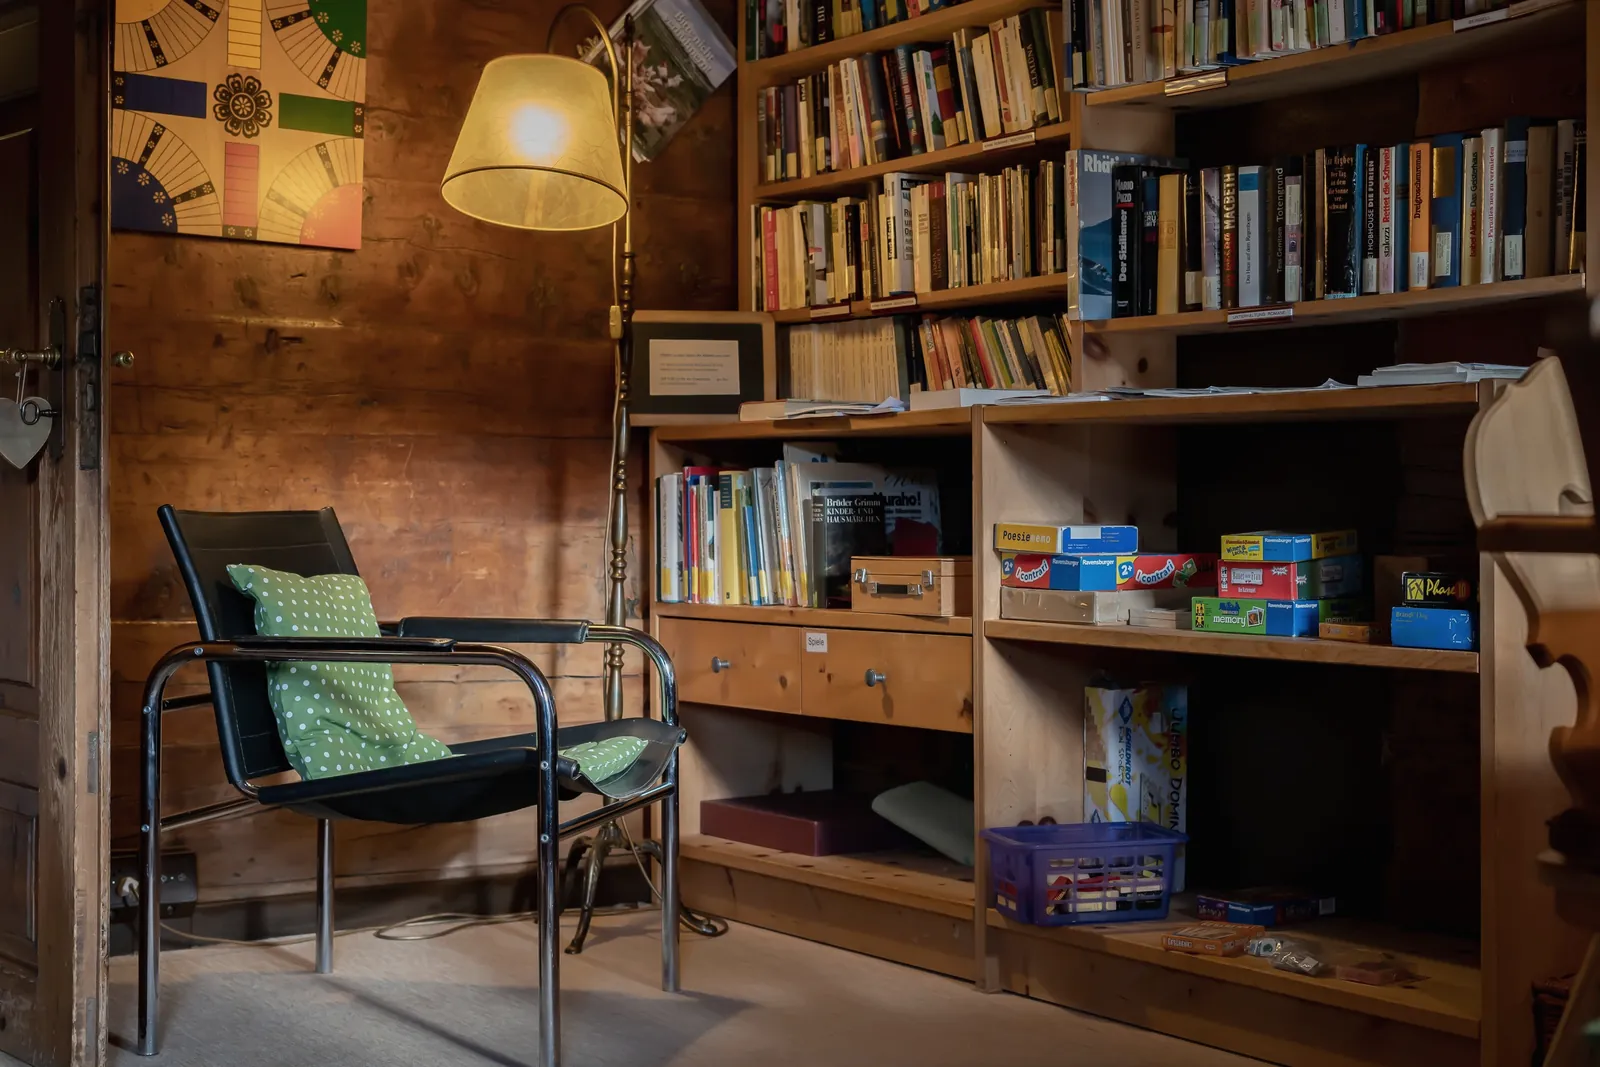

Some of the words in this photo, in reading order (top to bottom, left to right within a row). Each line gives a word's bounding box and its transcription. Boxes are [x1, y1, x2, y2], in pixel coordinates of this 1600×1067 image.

[816, 4, 826, 41] RBB
[1366, 160, 1374, 191] FURIEN
[1382, 148, 1390, 180] Schweiz
[1470, 152, 1478, 192] Geisterhaus
[1275, 167, 1284, 222] Totengrund
[1414, 150, 1423, 219] Dreigroschenroman
[1222, 172, 1235, 230] MACBETH
[1366, 192, 1374, 208] DIE
[1119, 209, 1128, 260] Sizilianer
[1367, 210, 1375, 251] HOBHOUSE
[1383, 227, 1391, 258] stalozzi
[1119, 261, 1128, 282] Der
[827, 498, 853, 507] Brüder
[854, 498, 881, 507] Grimm
[827, 507, 856, 515] KINDER-
[827, 515, 882, 523] HAUSMÄRCHEN
[1264, 537, 1293, 545] Ravensburger
[1004, 561, 1014, 574] 2+
[1020, 559, 1050, 583] contrari
[1052, 558, 1080, 569] Ravensburger
[1082, 559, 1115, 569] Ravensburger
[1120, 564, 1133, 577] 2+
[1141, 560, 1174, 584] contrari
[1407, 579, 1424, 600] FX
[1426, 578, 1456, 598] Phase
[1268, 602, 1293, 610] Ravensburger
[1295, 602, 1319, 610] Ravensburger
[1213, 614, 1246, 628] memory
[808, 636, 824, 648] Spiele
[1117, 726, 1125, 743] FUN
[1170, 707, 1184, 770] JUMBO
[1117, 749, 1125, 786] SPORTS
[1170, 777, 1183, 833] DOMIN
